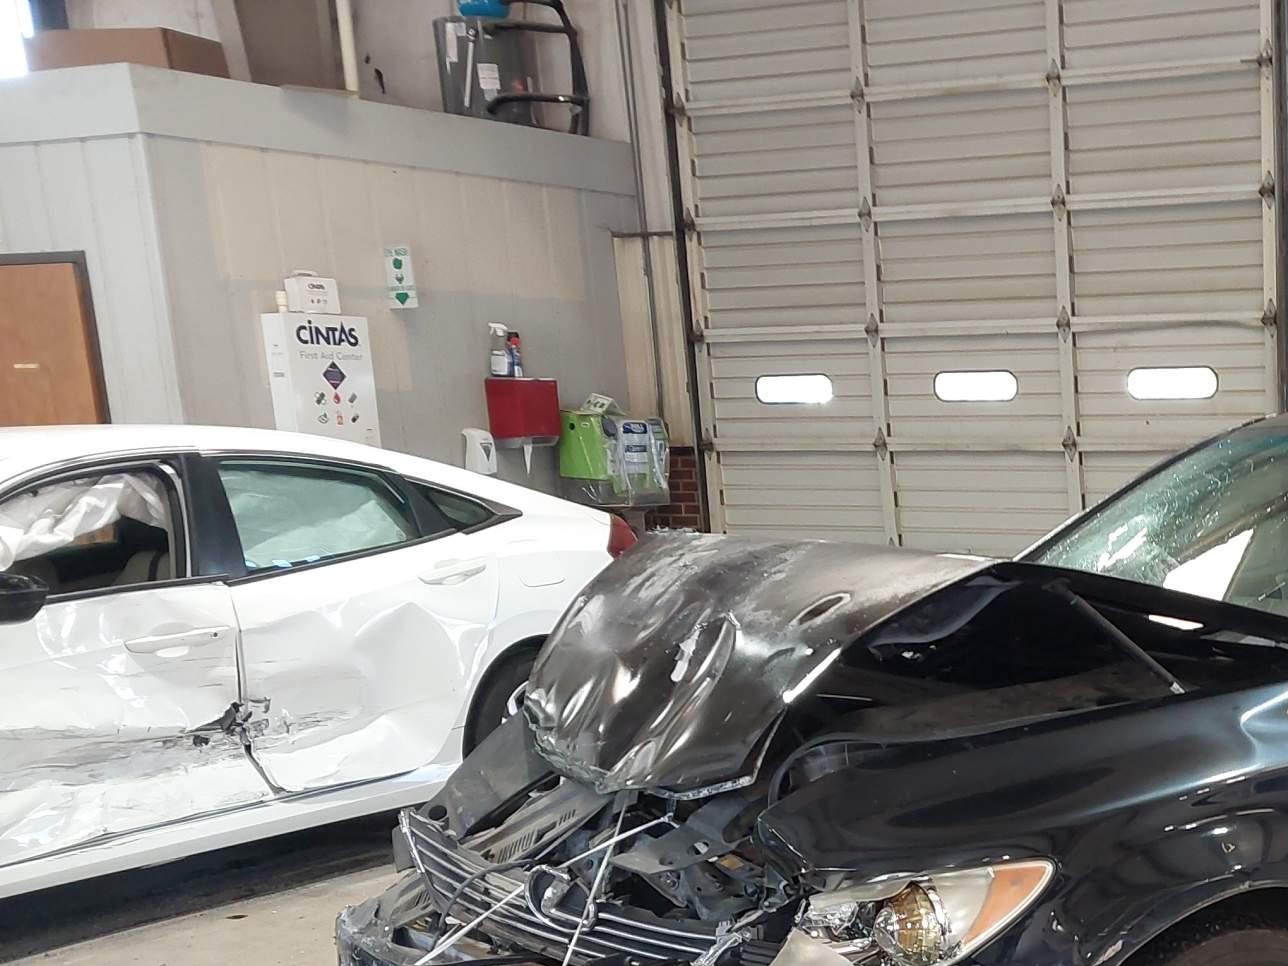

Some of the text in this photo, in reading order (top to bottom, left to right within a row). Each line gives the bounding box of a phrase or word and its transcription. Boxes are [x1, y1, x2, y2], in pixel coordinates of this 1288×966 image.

[299, 350, 363, 361] First Aid Center
